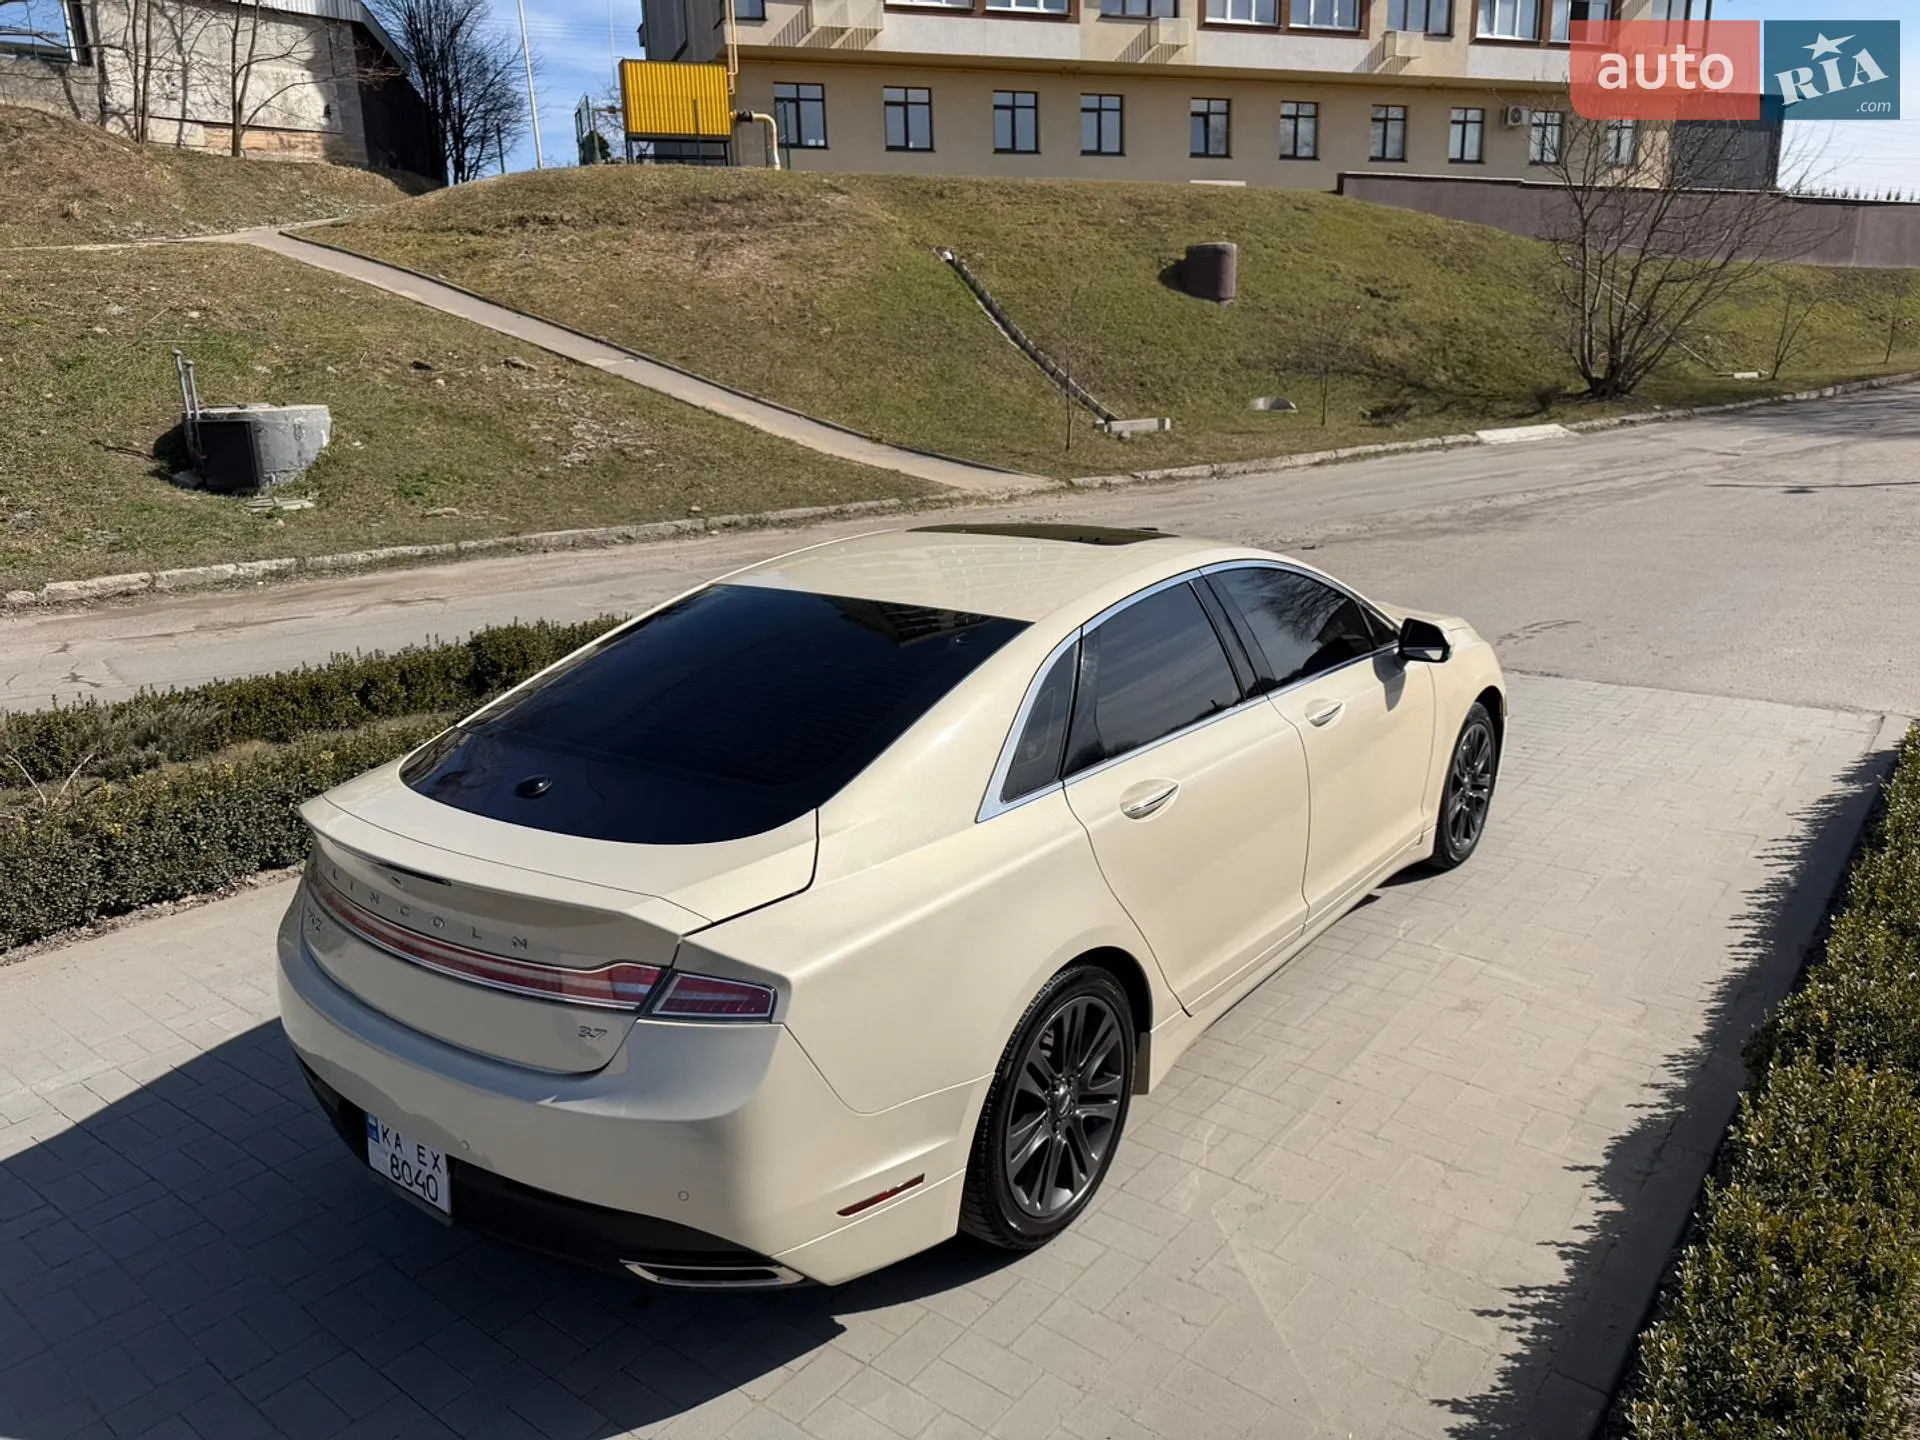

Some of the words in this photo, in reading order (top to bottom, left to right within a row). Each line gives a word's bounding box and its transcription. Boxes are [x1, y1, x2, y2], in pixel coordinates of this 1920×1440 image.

[332, 868, 528, 951] LINCOLN
[381, 1124, 404, 1154] KA
[417, 1143, 442, 1173] EX
[390, 1153, 439, 1202] 8040
